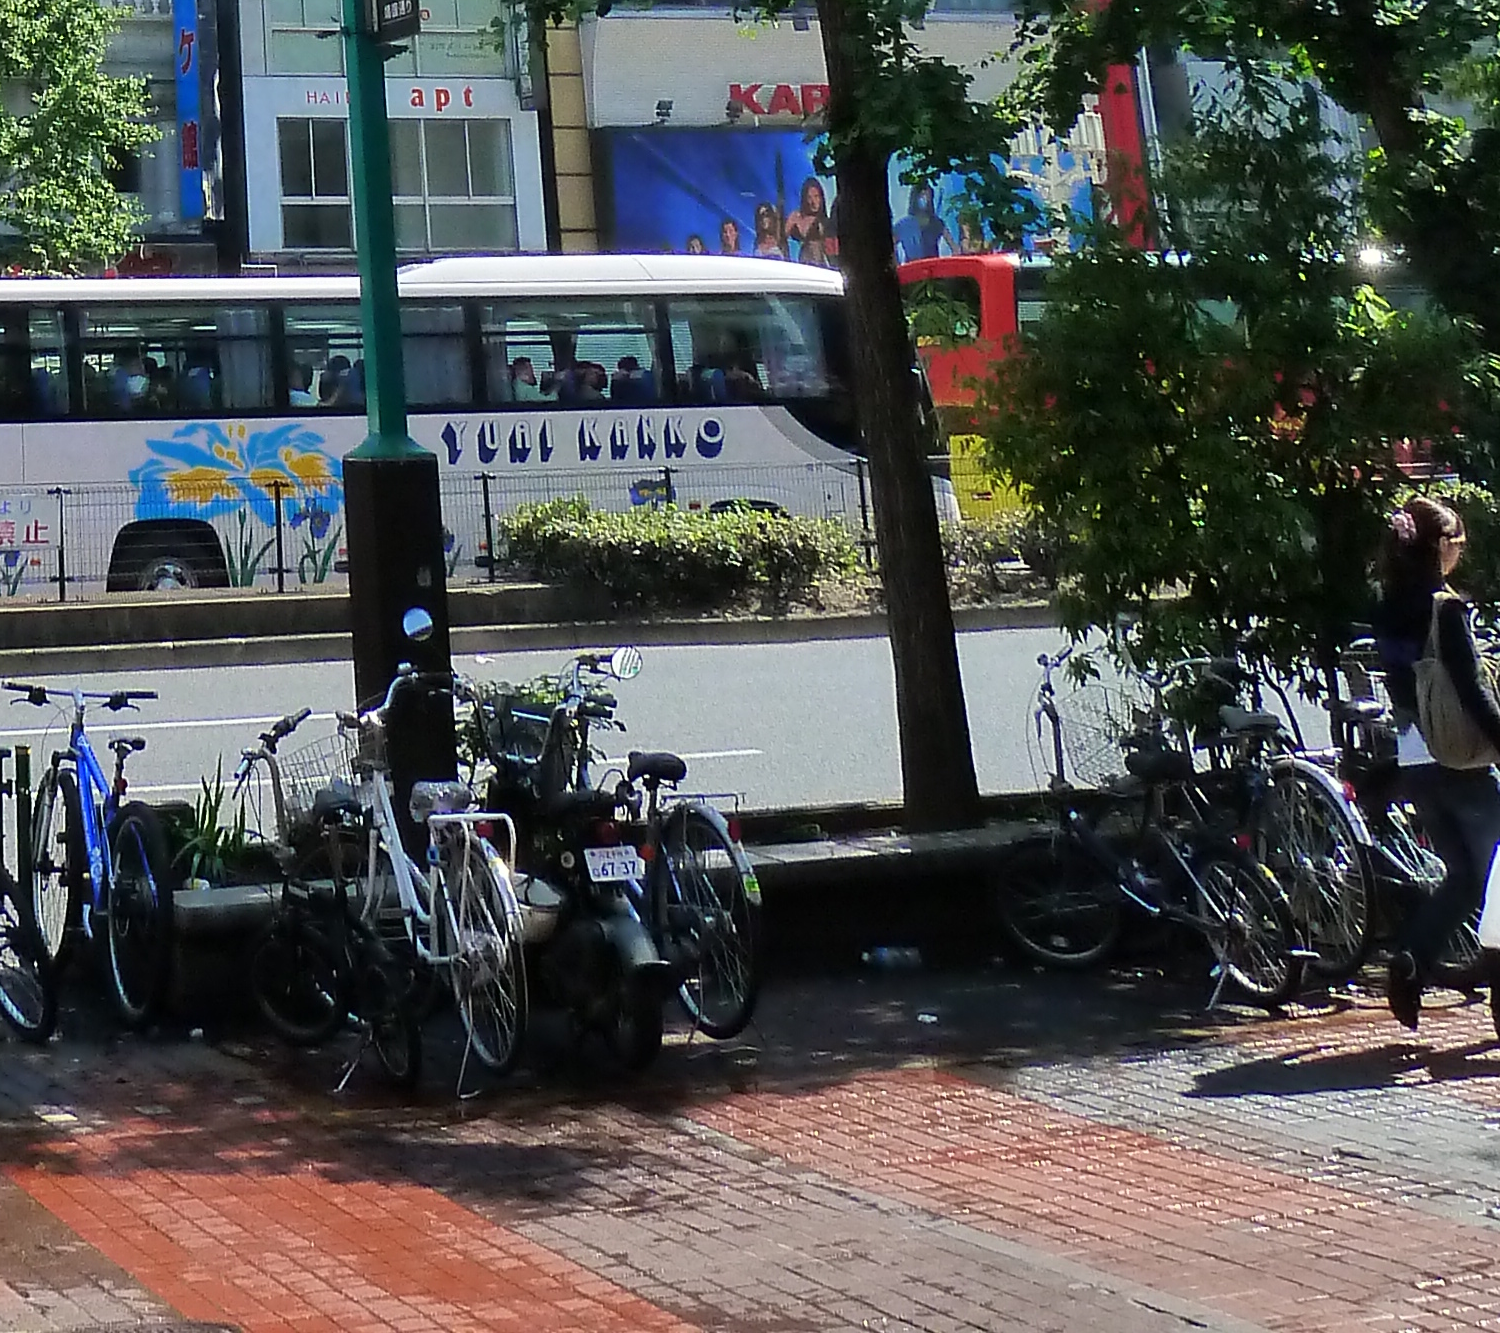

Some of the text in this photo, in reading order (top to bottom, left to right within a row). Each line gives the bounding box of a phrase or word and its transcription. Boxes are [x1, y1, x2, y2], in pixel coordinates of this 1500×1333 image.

[411, 85, 474, 112] apt
[728, 83, 829, 117] KAR
[441, 414, 725, 465] YUAI KANKO
